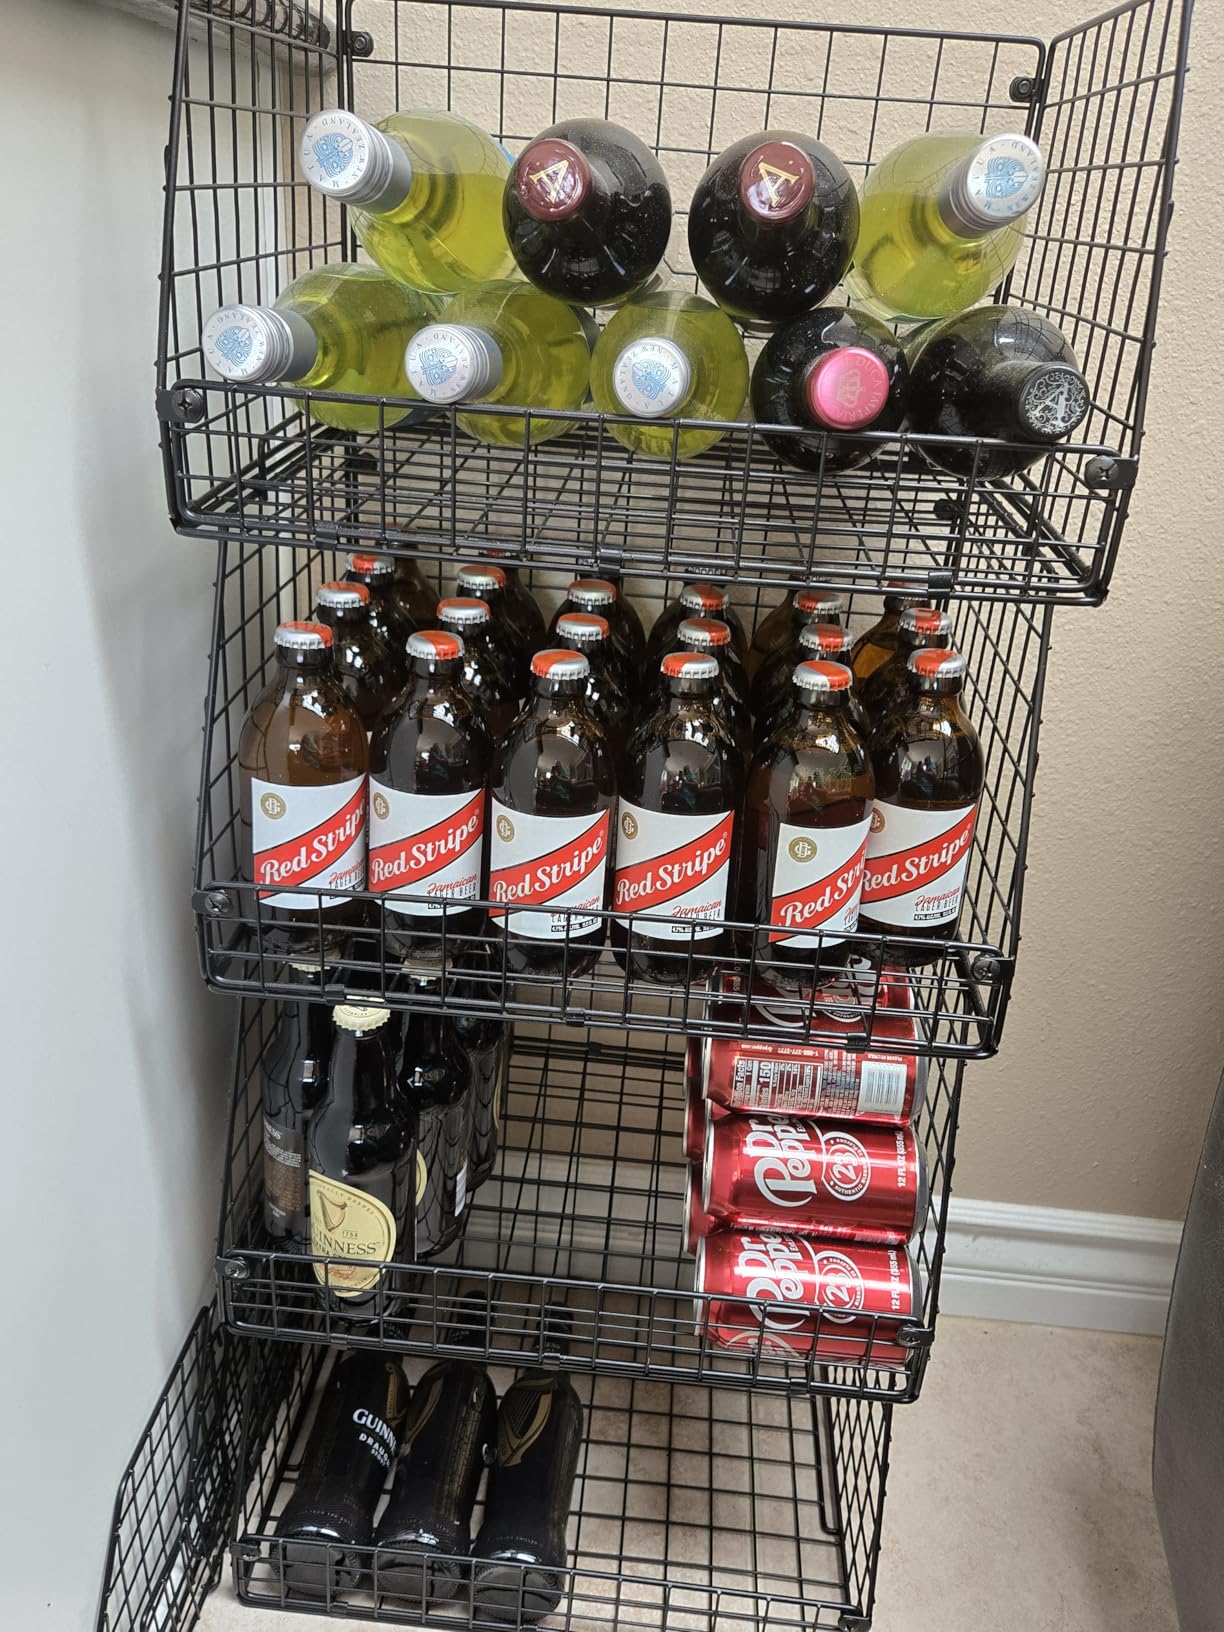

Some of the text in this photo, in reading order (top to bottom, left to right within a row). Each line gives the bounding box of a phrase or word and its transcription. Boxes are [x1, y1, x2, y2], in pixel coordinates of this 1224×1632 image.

[529, 160, 569, 204] A
[758, 162, 800, 207] A
[260, 846, 311, 885] Red
[372, 815, 479, 884] Red Stripe
[494, 836, 603, 903] Red Stripe
[616, 838, 726, 904] Red Stripe
[861, 829, 969, 892] Red Stripe
[779, 886, 833, 927] Red
[833, 849, 867, 900] Stri
[759, 1063, 771, 1084] 150
[743, 1119, 783, 1158] Dr
[754, 1115, 818, 1208] Peppe
[896, 1177, 906, 1188] 12
[835, 1183, 864, 1195] AUTHENTIC
[738, 1236, 777, 1278] Dr
[747, 1233, 811, 1330] Peppe
[891, 1299, 901, 1311] 12
[352, 1408, 397, 1456] GUINN
[359, 1433, 389, 1461] DRAUG
